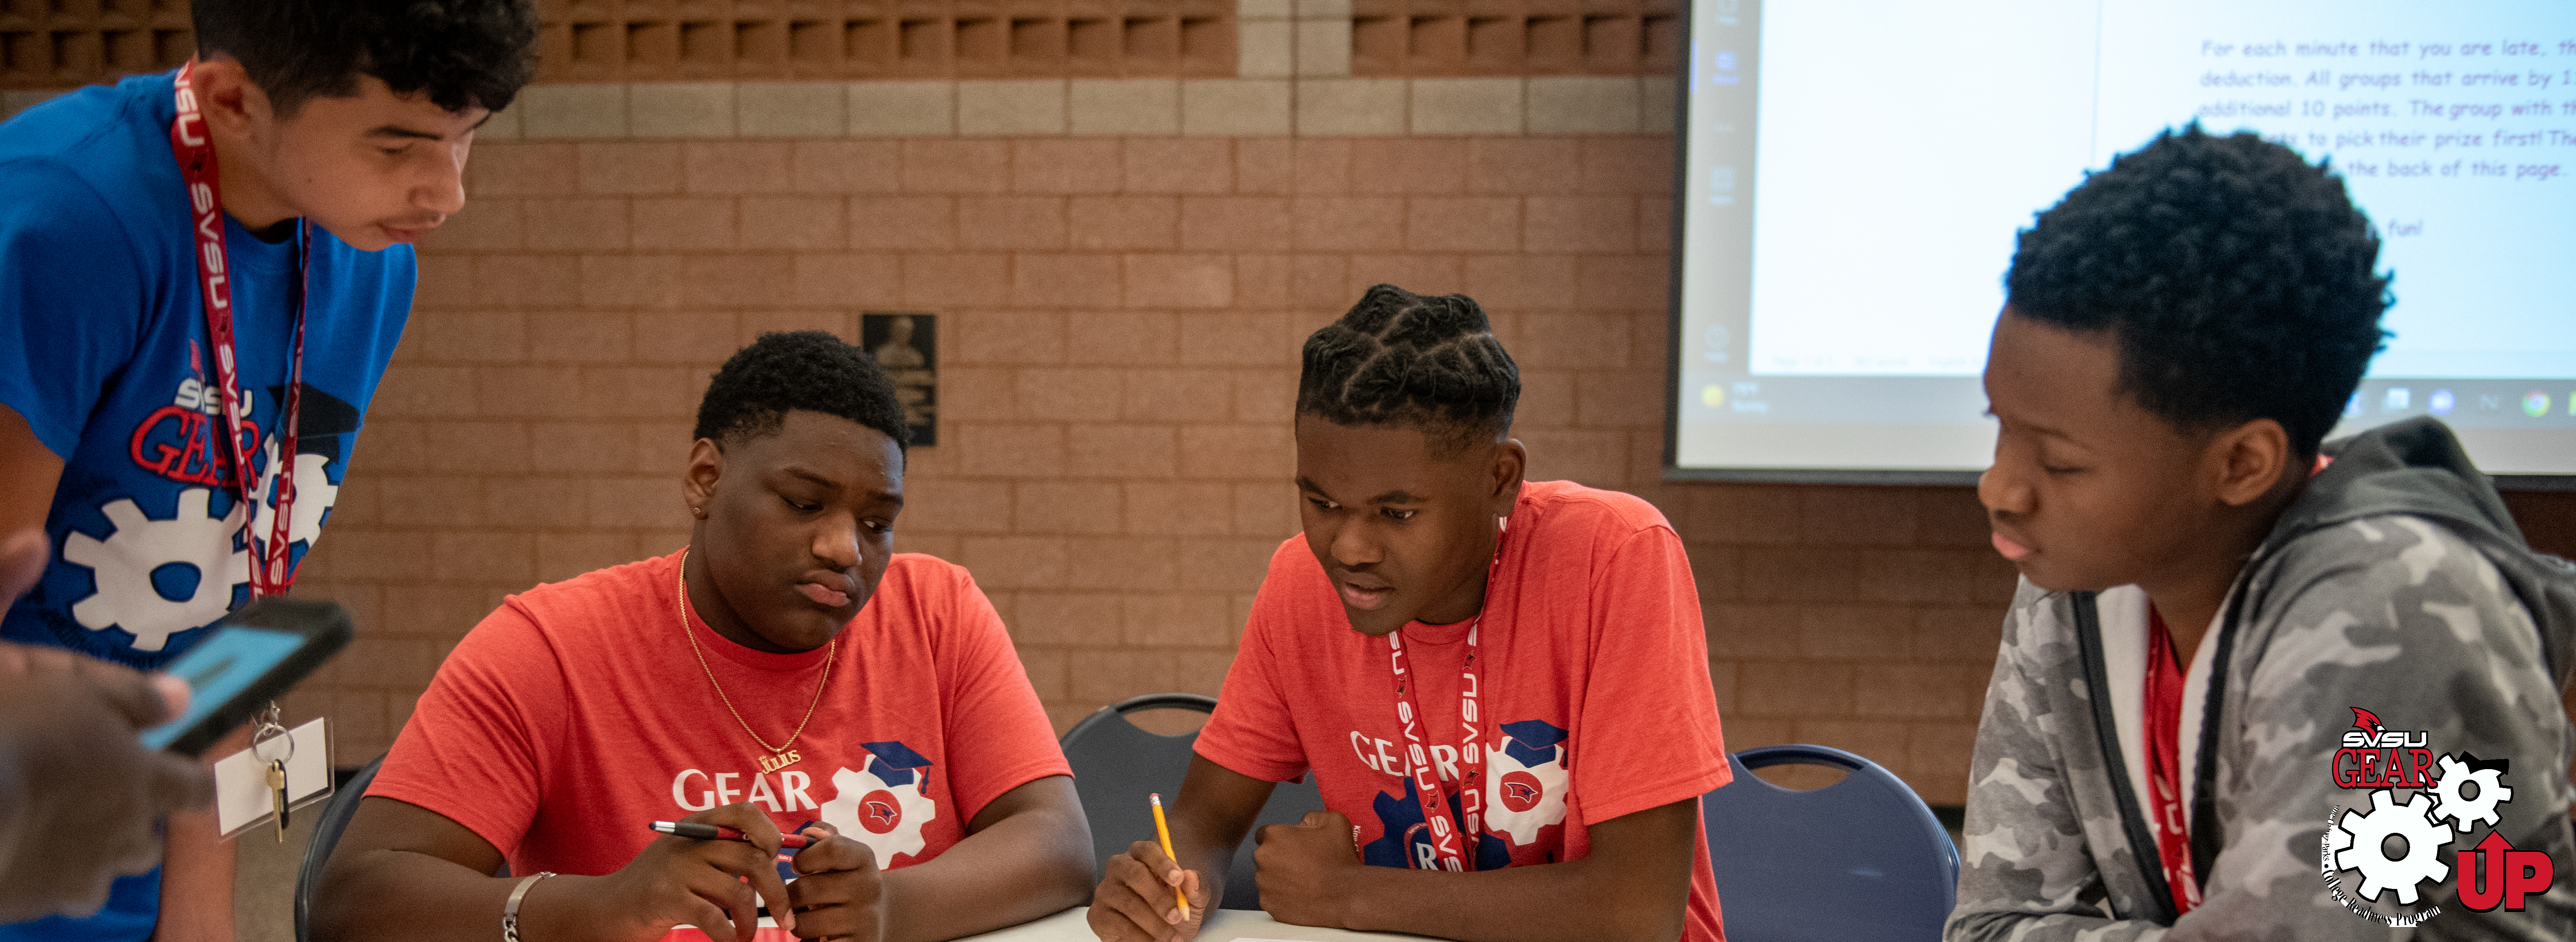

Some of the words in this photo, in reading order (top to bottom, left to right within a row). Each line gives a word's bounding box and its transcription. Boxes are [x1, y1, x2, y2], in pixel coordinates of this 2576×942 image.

[2201, 40, 2234, 57] For
[2243, 39, 2287, 57] each
[2296, 39, 2358, 57] minute
[2370, 39, 2410, 56] that
[2419, 44, 2452, 60] you
[2460, 43, 2491, 56] are
[2305, 69, 2331, 85] All
[2339, 73, 2401, 91] groups
[2412, 71, 2453, 85] that
[2461, 69, 2519, 86] arrive
[2528, 70, 2552, 89] by
[2198, 99, 2292, 118] additional
[2302, 99, 2325, 117] 10
[2408, 99, 2444, 116] The
[2449, 104, 2502, 122] group
[2511, 99, 2552, 116] with
[2308, 131, 2327, 147] to
[2335, 130, 2373, 151] pick
[2380, 130, 2426, 147] their
[2435, 130, 2482, 151] prize
[2493, 129, 2542, 147] first!
[2348, 160, 2378, 177] the
[2388, 160, 2431, 177] back
[2440, 159, 2462, 178] of
[2471, 160, 2507, 176] this
[2388, 218, 2423, 237] fun!
[191, 182, 227, 309] SVSU
[270, 471, 291, 584] SVSU
[1463, 673, 1479, 763] SVSU
[1398, 701, 1435, 790] SVSU
[761, 750, 801, 774] JULIUS
[673, 769, 818, 812] GEAR
